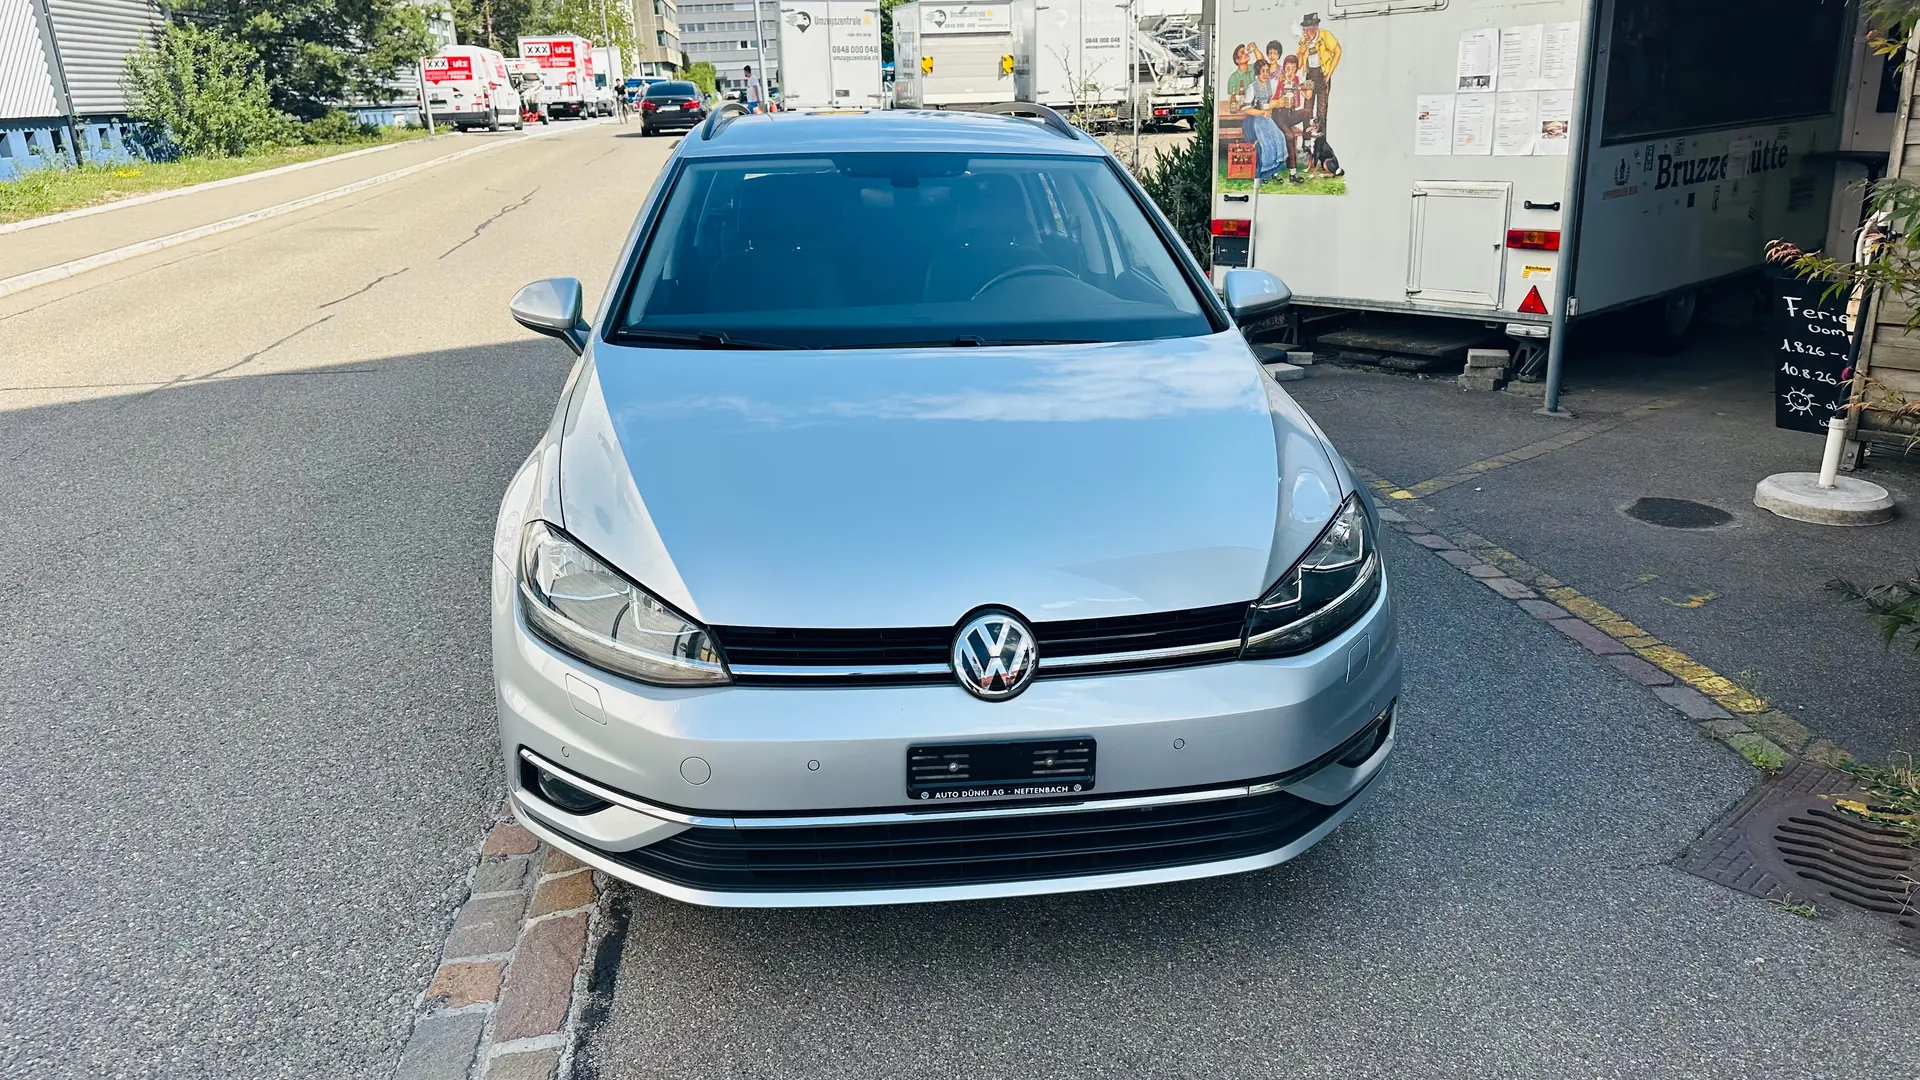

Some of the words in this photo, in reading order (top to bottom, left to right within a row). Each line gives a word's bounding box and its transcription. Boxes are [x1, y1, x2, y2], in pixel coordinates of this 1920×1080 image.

[1782, 296, 1849, 324] Ferie
[1781, 339, 1825, 356] 1.8.26
[1781, 361, 1836, 385] 10.8.26
[934, 791, 959, 799] AUTO
[962, 788, 989, 797] DÜNKI
[1014, 786, 1068, 795] NEFTENBACH
